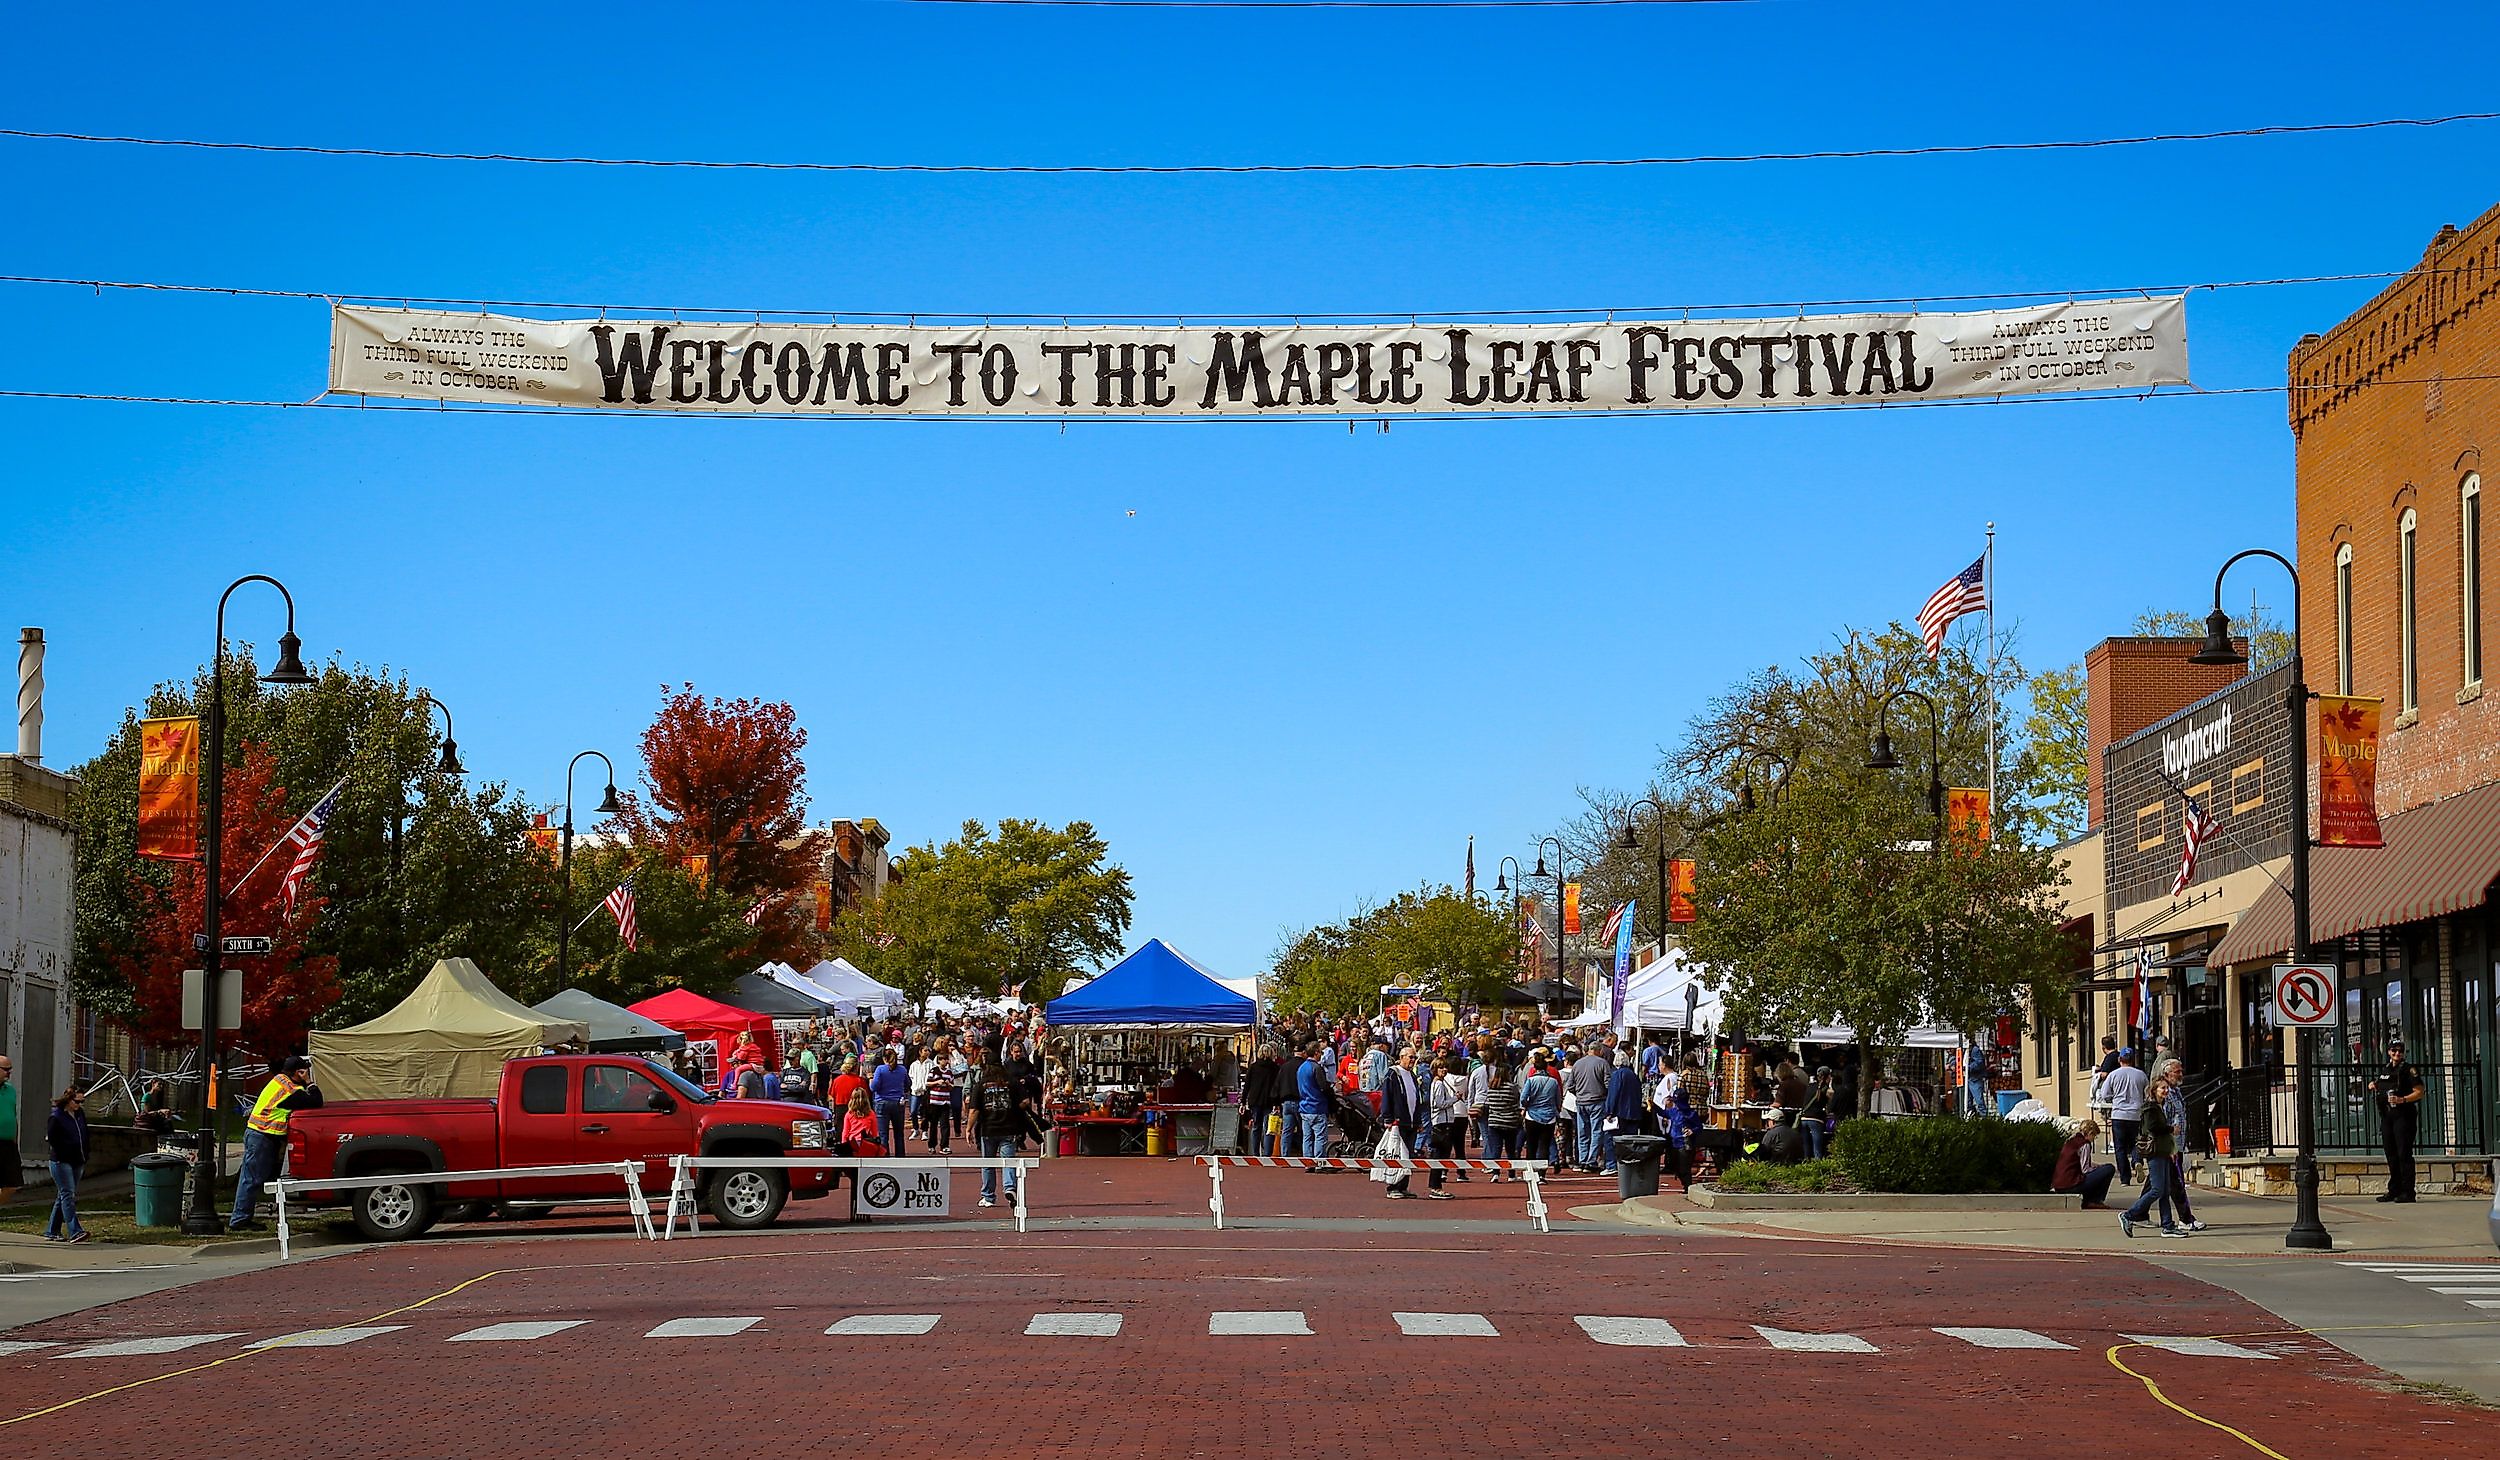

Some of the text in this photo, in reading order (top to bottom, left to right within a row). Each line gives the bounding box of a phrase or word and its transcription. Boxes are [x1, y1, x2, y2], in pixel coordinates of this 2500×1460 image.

[407, 327, 526, 348] ALWAYS THE
[1992, 316, 2110, 338] ALWAYS THE
[363, 344, 569, 372] THIRD FULL WEEKEND
[1949, 335, 2156, 363] THIRD FULL WEEKEND
[587, 325, 1935, 410] WELCOME TO THE MAPLE LEAF FESTIVAL
[1999, 360, 2108, 382] IN OCTOBER
[411, 369, 520, 391] IN OCTOBER
[2161, 701, 2233, 780] Vaughncraft
[2321, 734, 2376, 764] Maple
[143, 754, 196, 780] Maple
[141, 809, 196, 818] FESTIVAL
[1950, 815, 1989, 830] Male
[228, 939, 253, 950] SIXTH
[917, 1172, 940, 1193] NO
[904, 1189, 943, 1209] PETS
